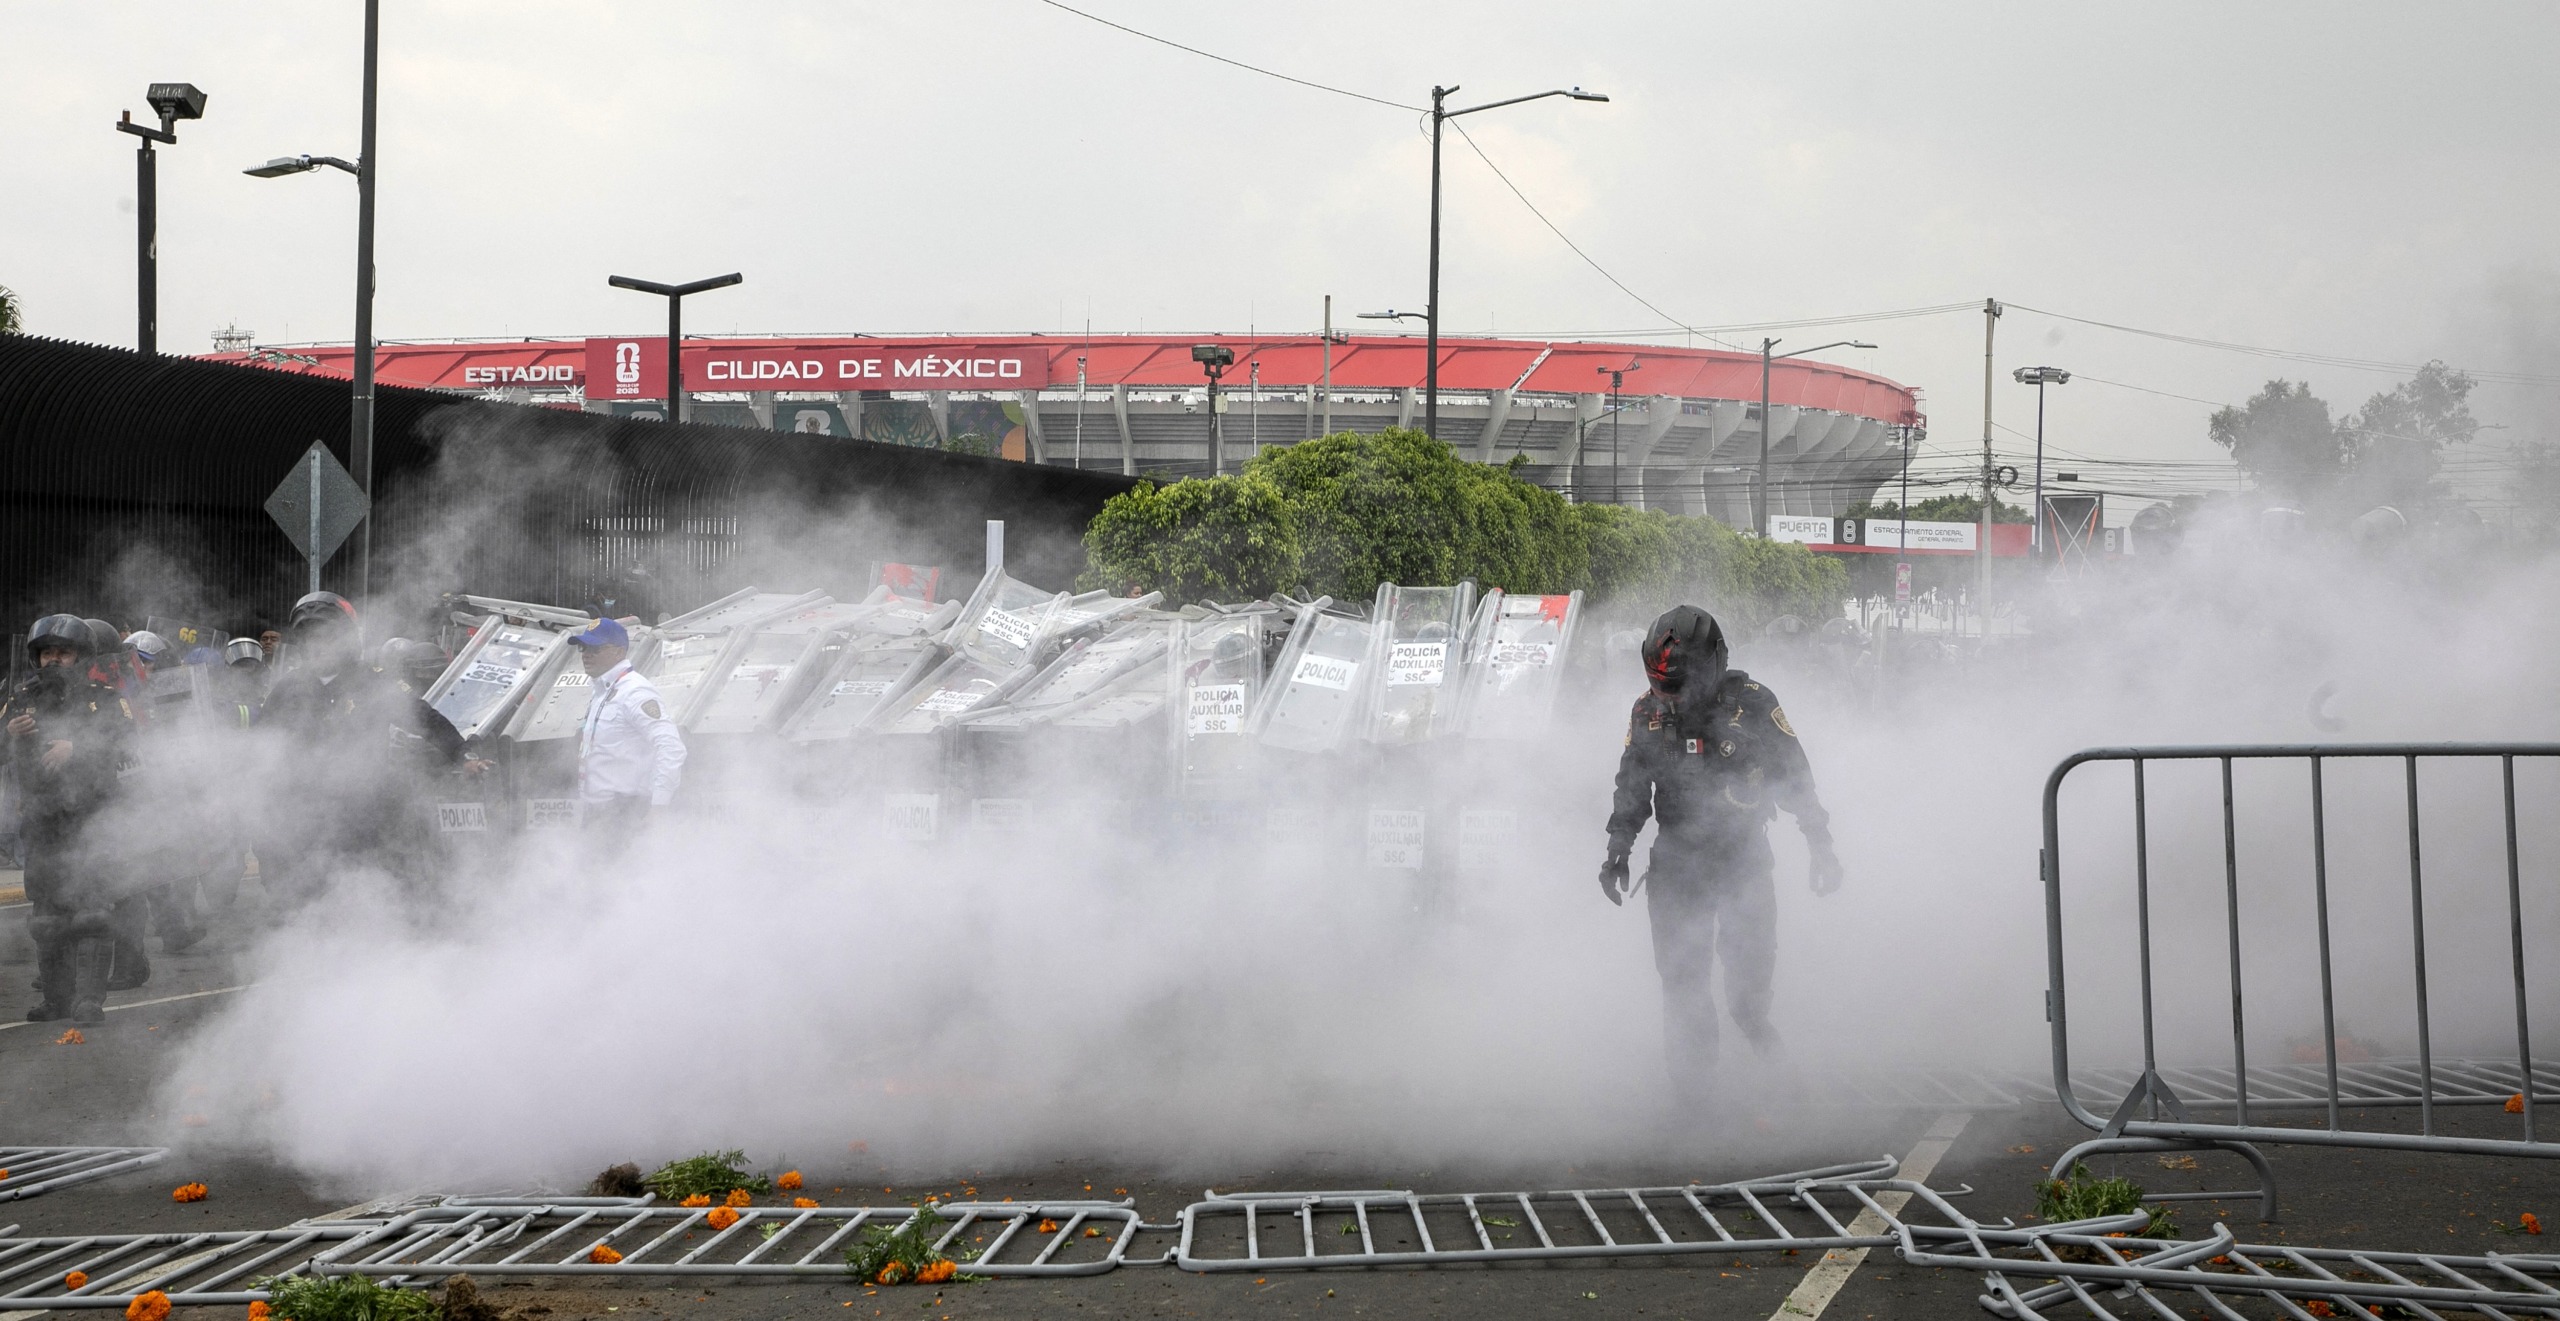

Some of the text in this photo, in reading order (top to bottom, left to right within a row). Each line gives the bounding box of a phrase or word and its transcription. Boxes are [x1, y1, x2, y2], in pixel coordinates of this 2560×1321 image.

[707, 354, 1022, 380] CIUDAD DE MÉXICO
[465, 365, 574, 383] ESTADIO
[1779, 521, 1828, 533] PUERTA
[1842, 519, 1857, 543] 8
[1873, 526, 1964, 537] ESTACIOAMIENTO GENERAL
[985, 616, 1031, 640] AUXILIAR
[993, 628, 1013, 641] SSC
[179, 626, 198, 644] 66
[1392, 659, 1444, 669] AUXILIAR
[1498, 651, 1545, 664] SSC
[556, 675, 591, 686] POLI
[1404, 672, 1426, 682] SSC
[1190, 704, 1243, 716] AUXILIAR
[1204, 719, 1227, 731] SSC
[1383, 850, 1406, 863] SSC
